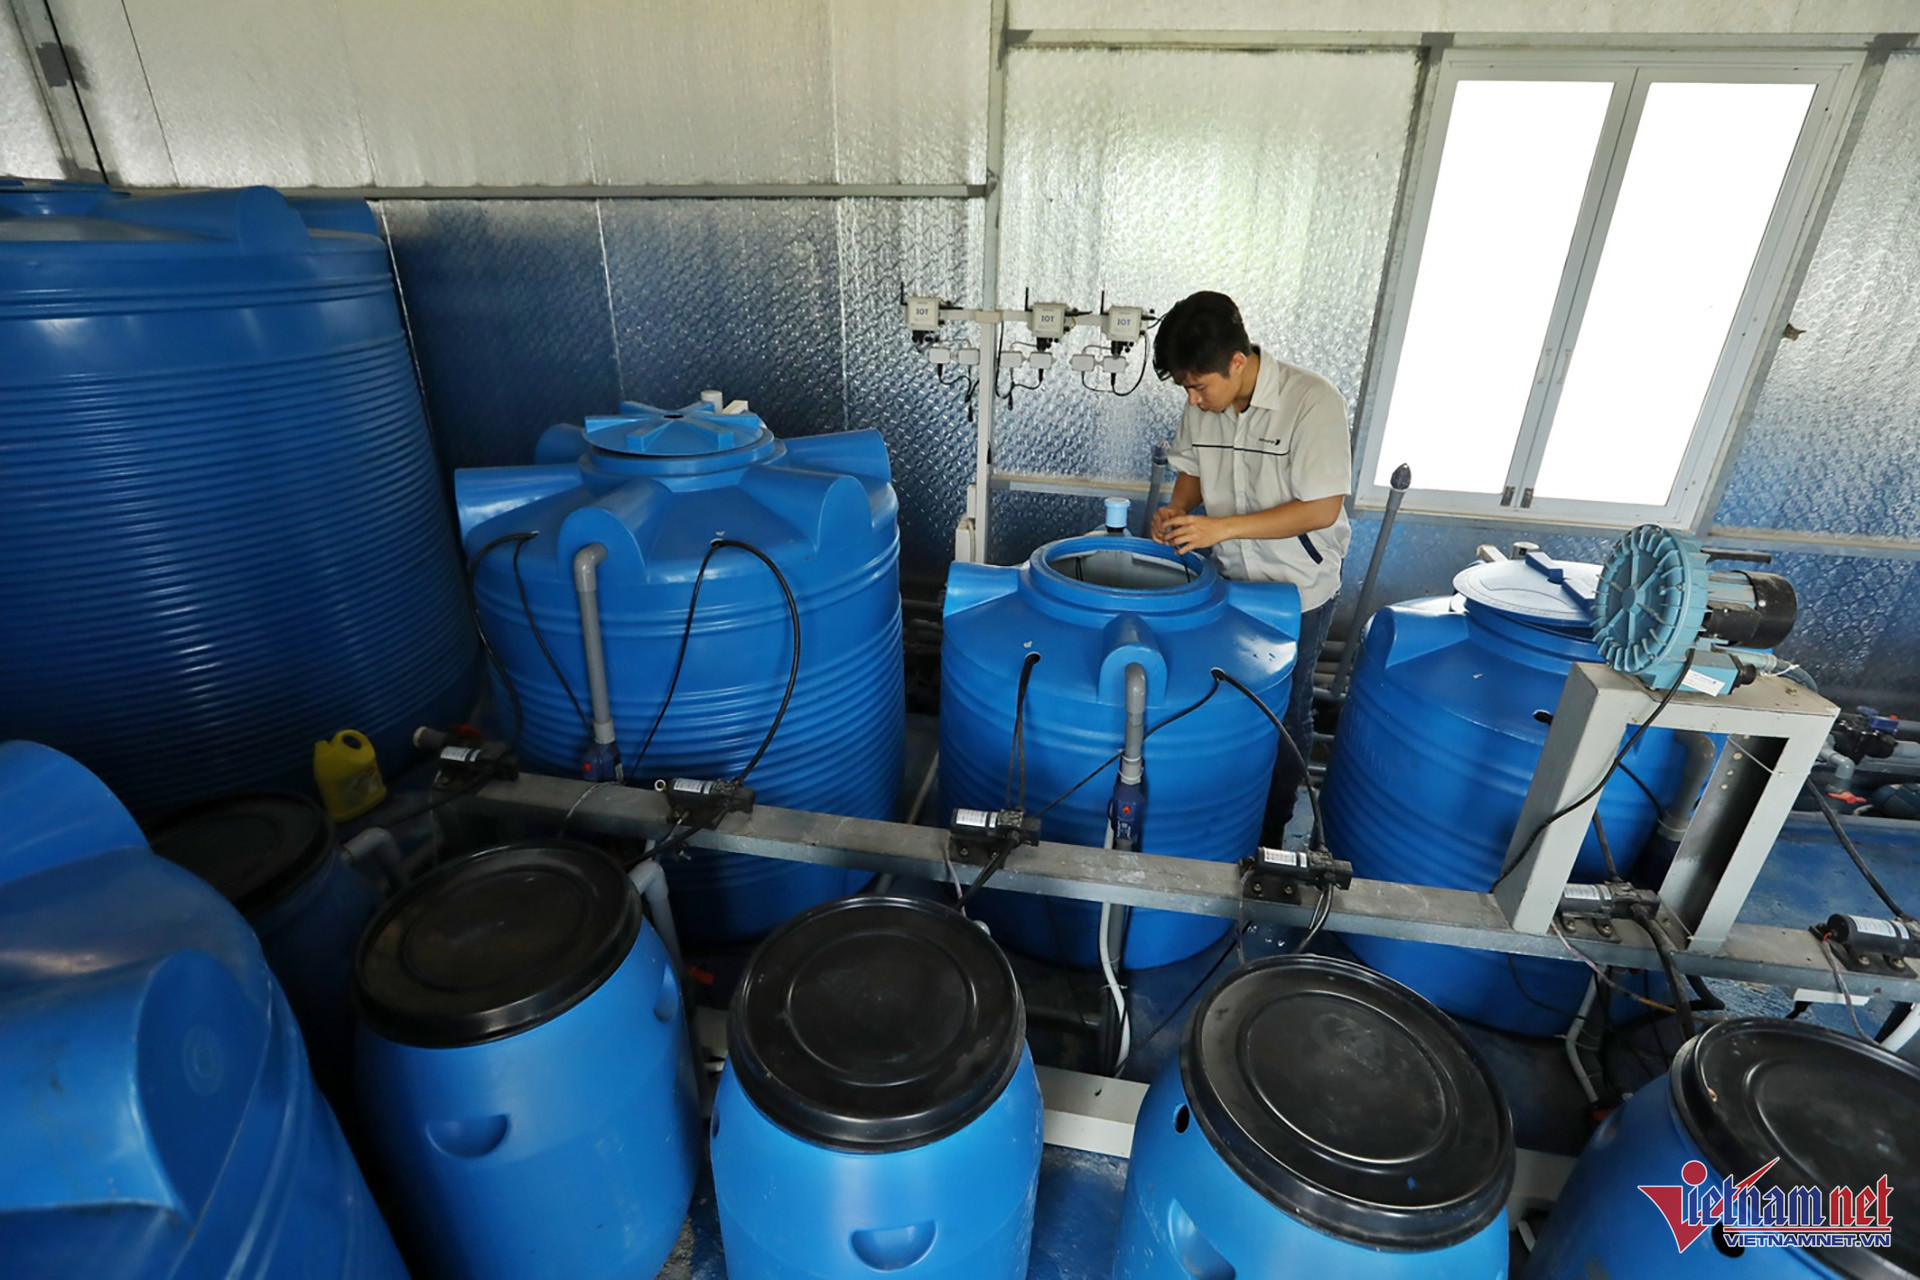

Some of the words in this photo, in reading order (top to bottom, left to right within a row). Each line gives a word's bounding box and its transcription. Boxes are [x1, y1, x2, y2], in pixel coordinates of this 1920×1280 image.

[916, 308, 929, 316] IOT
[1041, 315, 1055, 323] IOT
[1117, 318, 1131, 326] IOT
